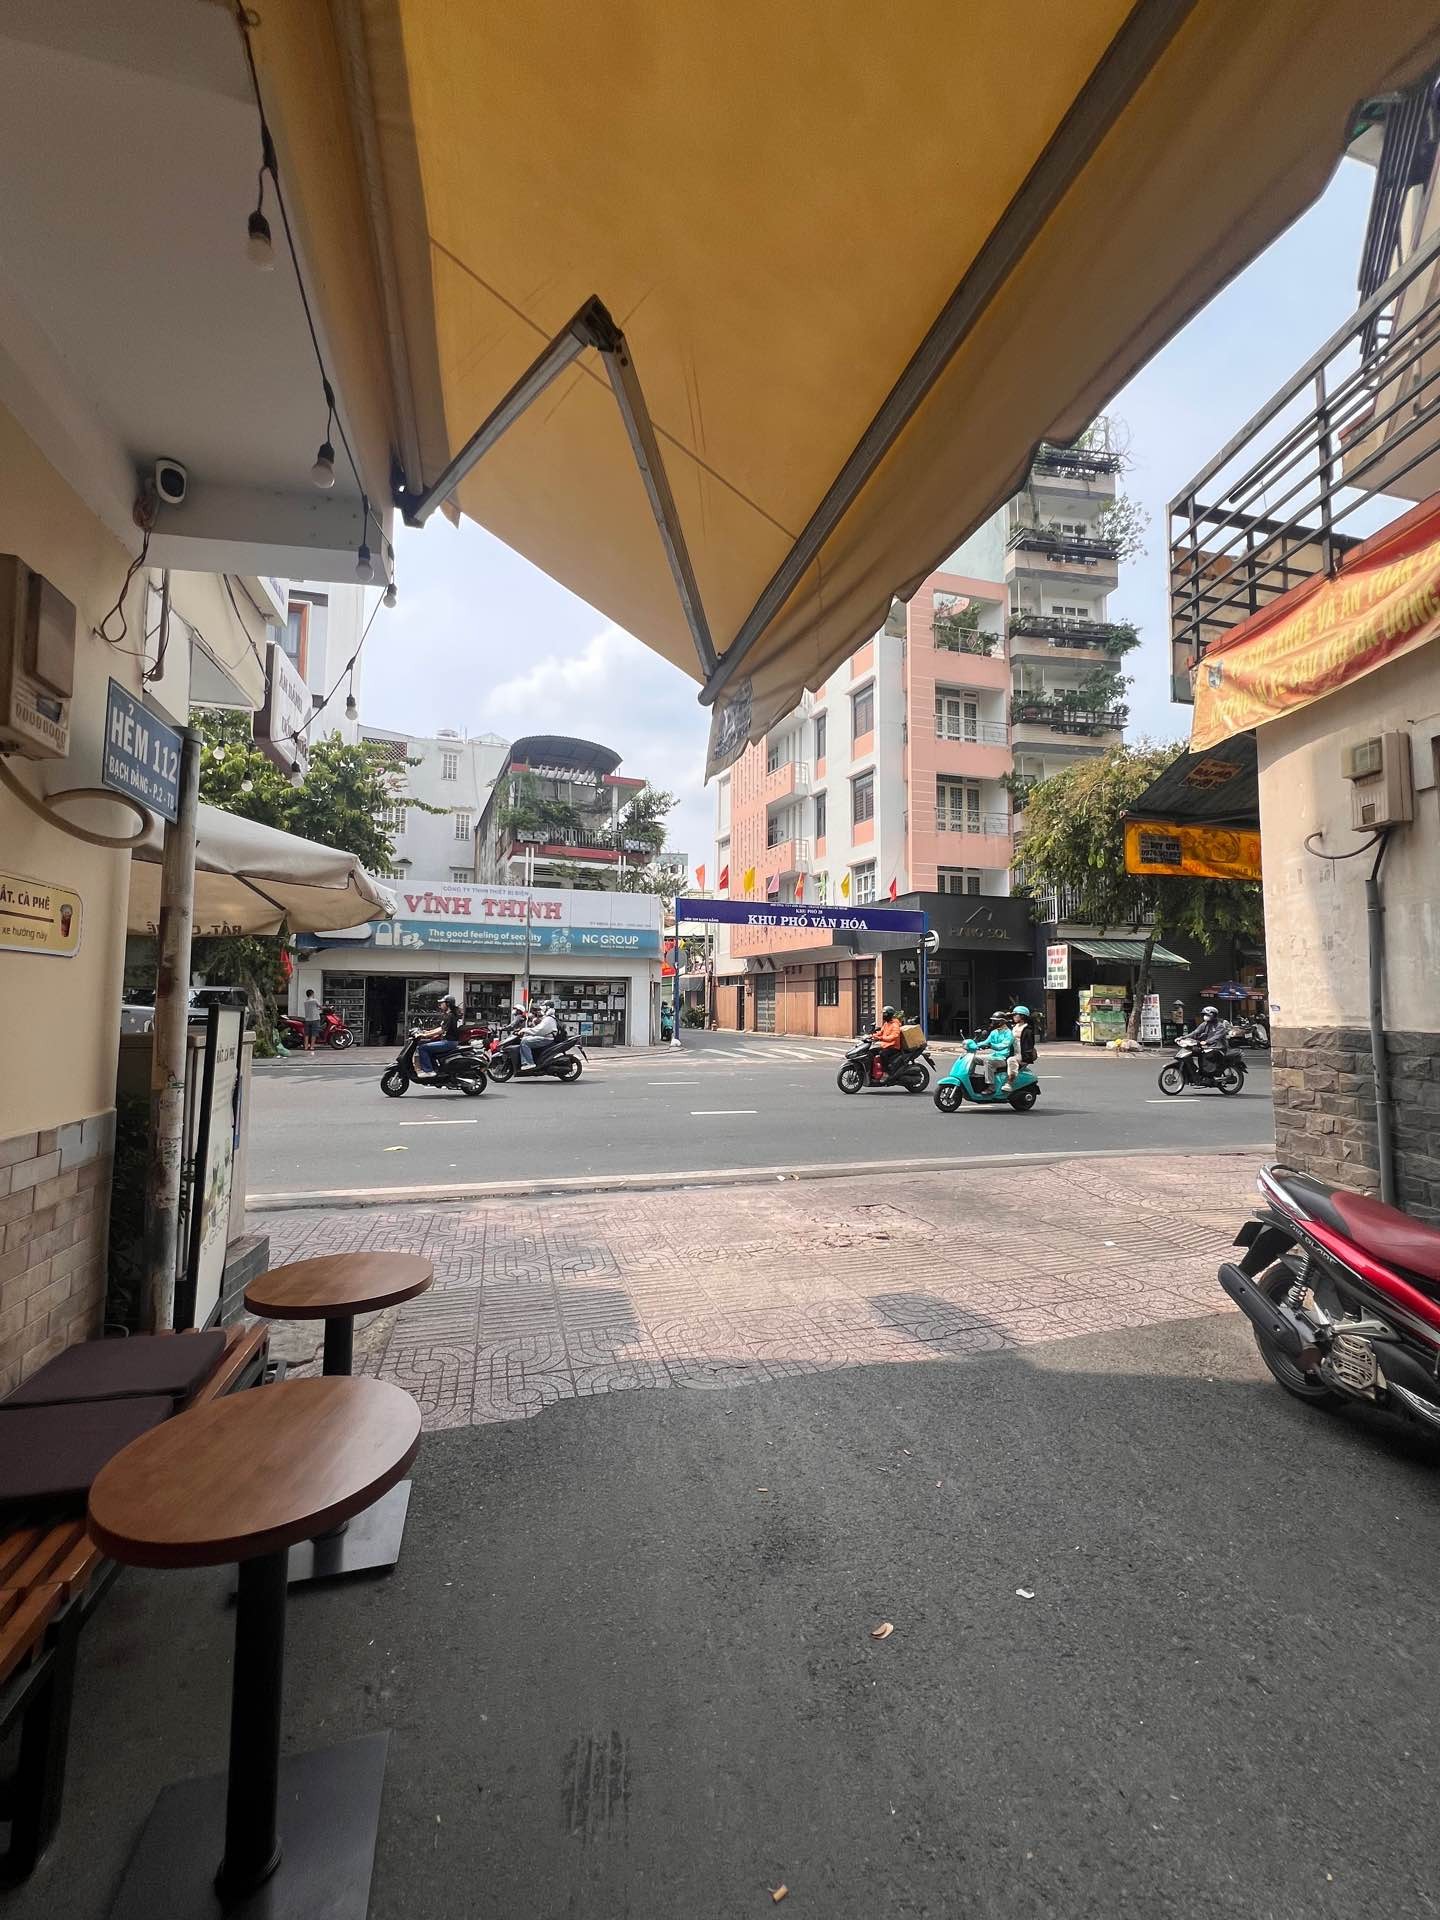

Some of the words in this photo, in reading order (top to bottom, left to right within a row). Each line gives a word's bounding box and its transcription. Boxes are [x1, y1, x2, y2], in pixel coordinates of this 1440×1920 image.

[111, 703, 149, 765] HẺM
[152, 740, 178, 785] 112
[0, 884, 15, 904] ẤT.
[18, 891, 30, 907] CÀ
[32, 896, 51, 911] PHÊ
[404, 892, 471, 915] VĨNH
[481, 898, 562, 922] THỊNH
[748, 914, 777, 926] KHU
[778, 913, 808, 928] PHỐ
[811, 916, 838, 928] VĂN
[840, 918, 868, 930] HÓA
[429, 929, 444, 938] The
[447, 930, 469, 939] good
[470, 931, 500, 940] feeling
[511, 933, 542, 942] secity
[581, 934, 599, 944] NC
[600, 935, 639, 945] GROUP
